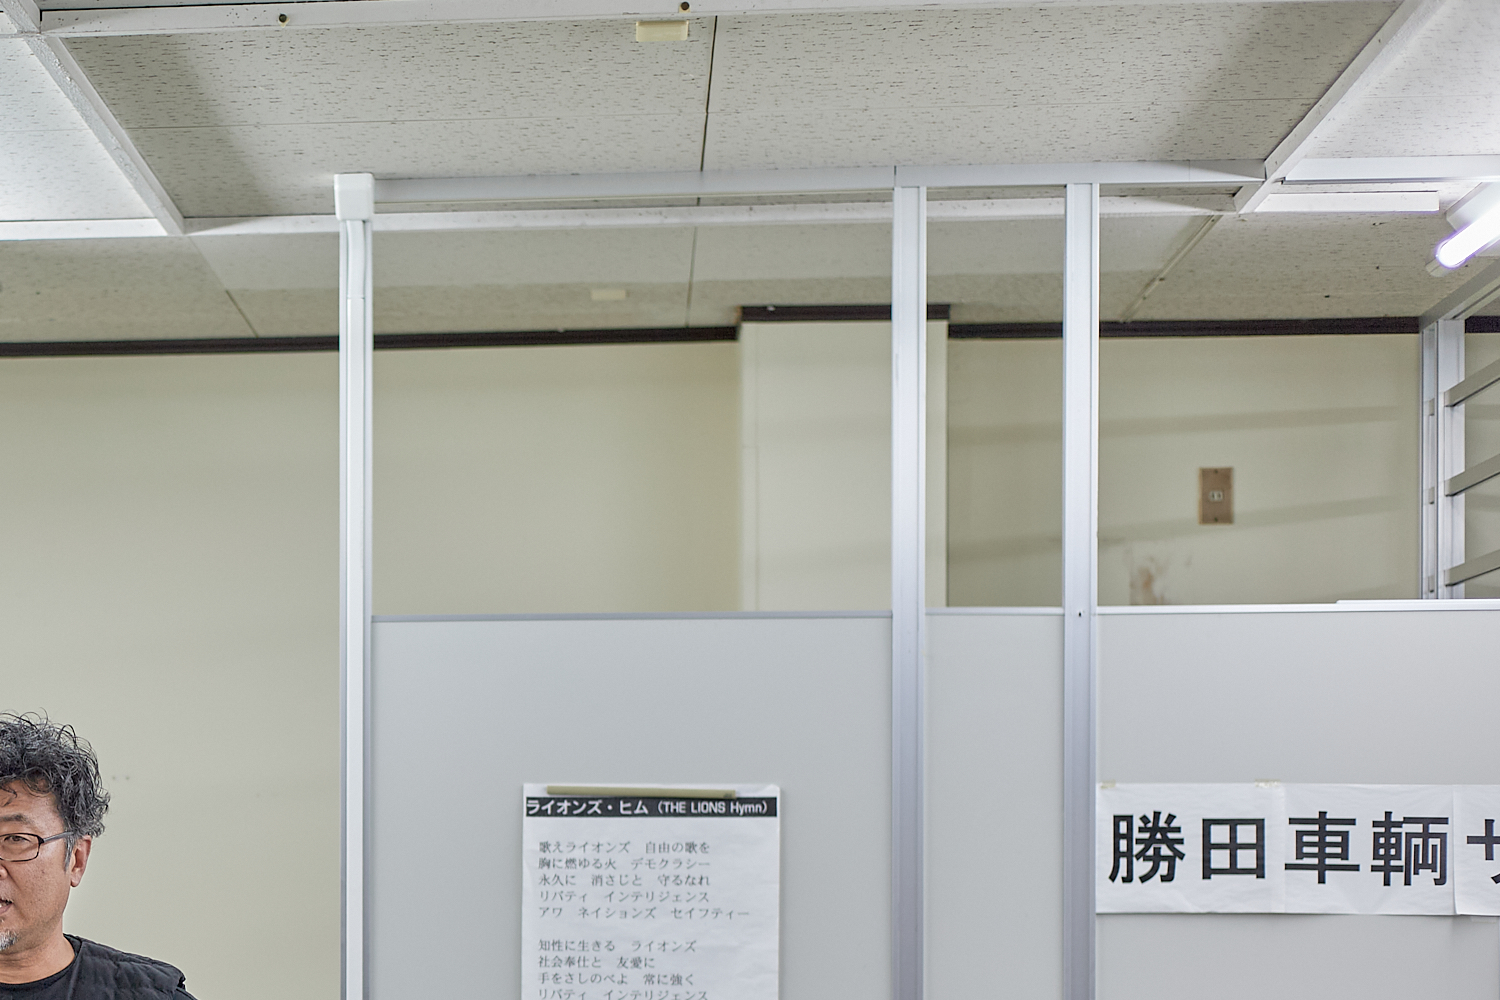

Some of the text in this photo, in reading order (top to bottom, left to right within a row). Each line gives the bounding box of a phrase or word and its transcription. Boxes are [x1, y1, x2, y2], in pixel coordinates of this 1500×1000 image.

[526, 799, 649, 816] ライオンズ・ヒム
[690, 800, 726, 815] LIONS
[539, 840, 710, 855] 歌えライオンズ 自由の歌を
[630, 857, 710, 870] デモクラシー
[538, 873, 710, 887] 永久に 消さじと 守るなれ
[540, 890, 709, 903] リバティ インテリジェンス
[539, 906, 749, 920] アワ ネイションズ セイフティー
[538, 938, 697, 953] 知性に生きる ライオンズ
[538, 955, 655, 970] 社会奉仕と 友愛に
[538, 971, 694, 987] 手をさしのべよ 常に強く
